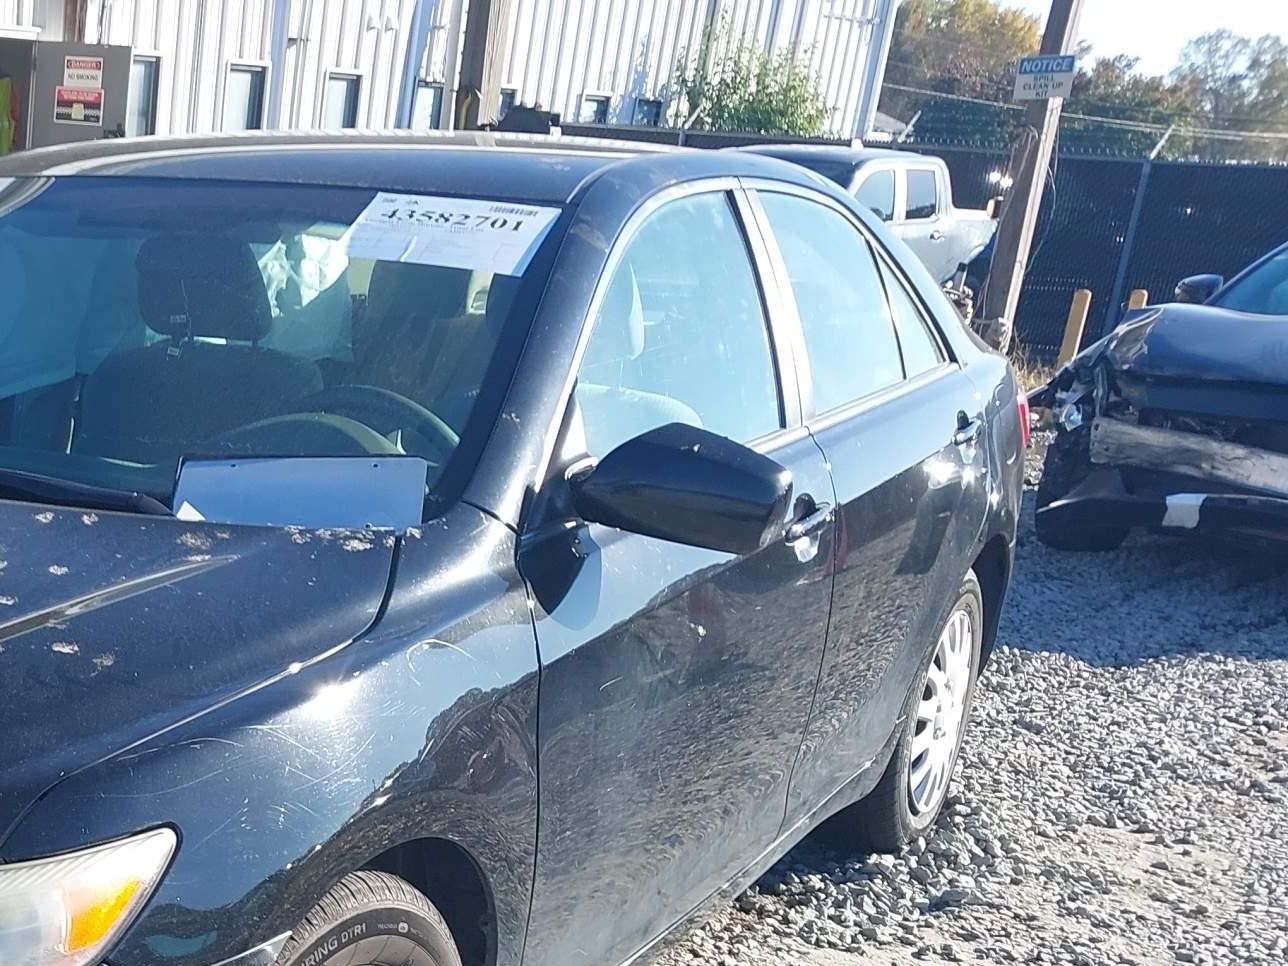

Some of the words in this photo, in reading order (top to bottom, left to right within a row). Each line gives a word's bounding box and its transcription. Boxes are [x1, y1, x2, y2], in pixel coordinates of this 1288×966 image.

[71, 61, 97, 69] DANGER
[1021, 58, 1072, 73] NOTICE
[76, 73, 99, 81] SMOKING
[1023, 83, 1048, 91] CLEAN
[381, 208, 525, 232] 43582701
[341, 922, 368, 943] DTR1
